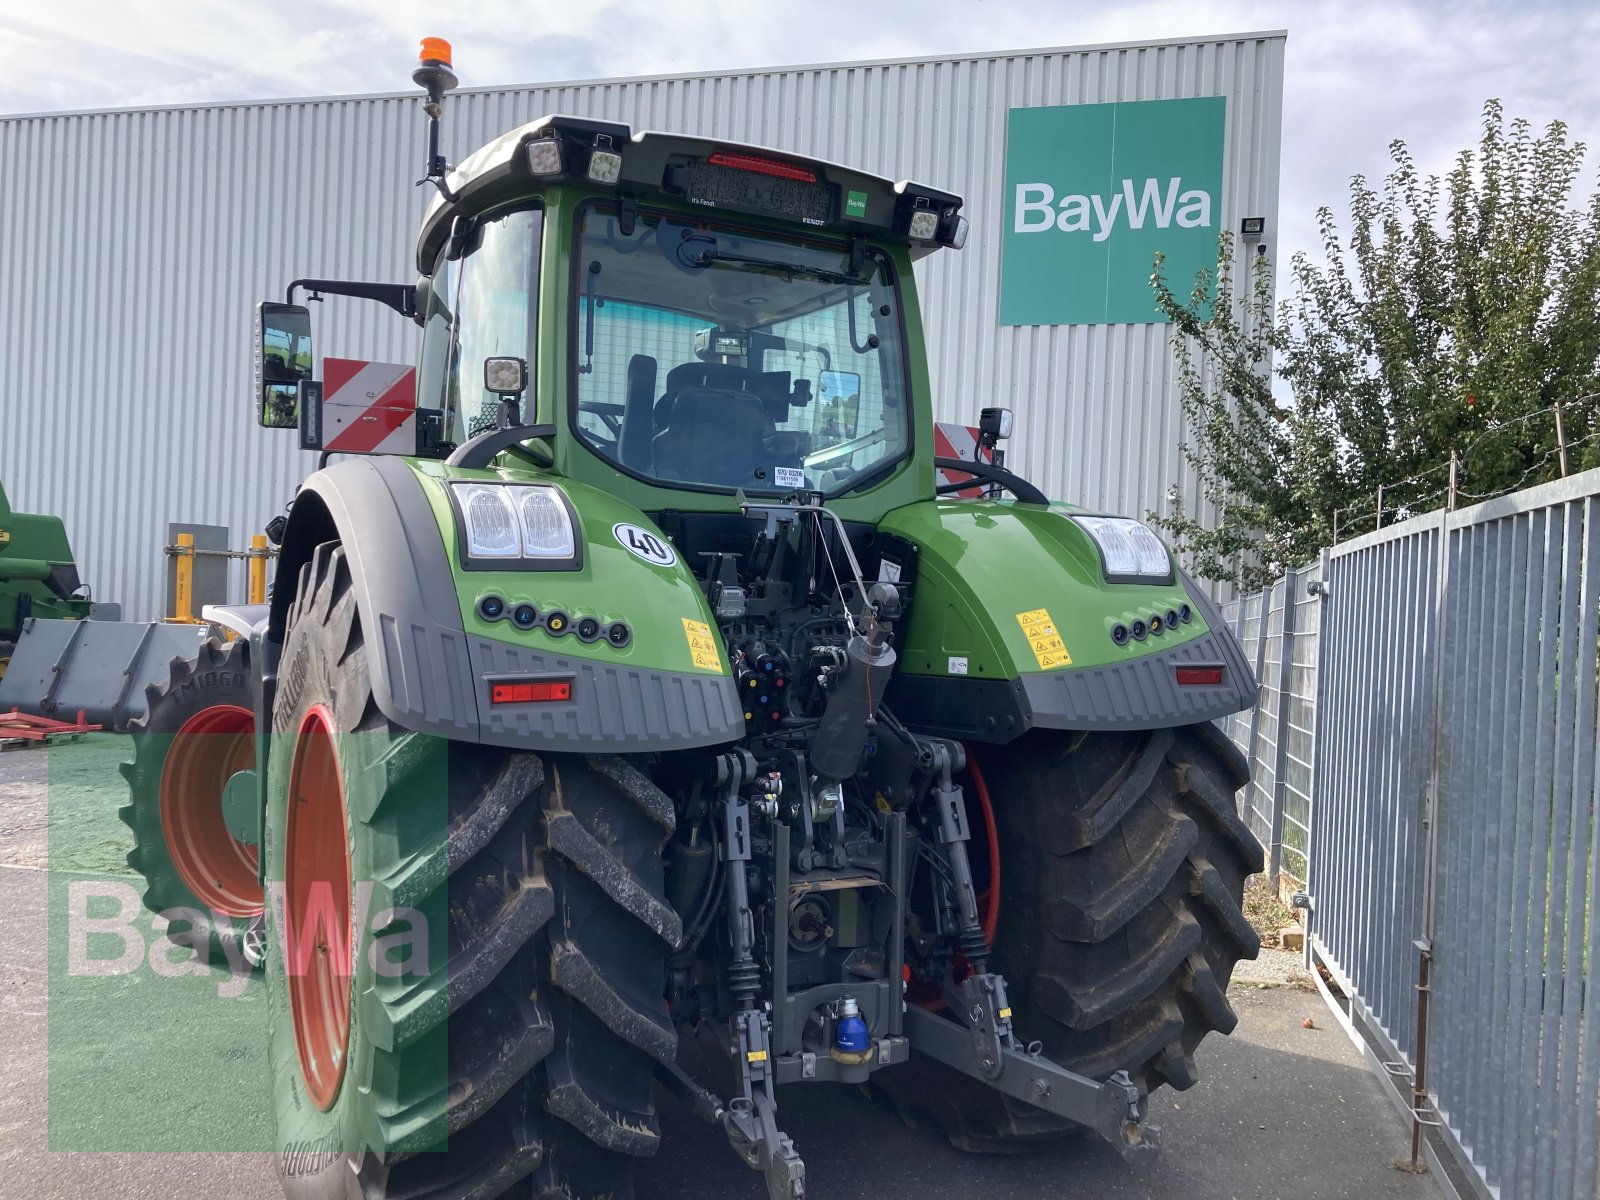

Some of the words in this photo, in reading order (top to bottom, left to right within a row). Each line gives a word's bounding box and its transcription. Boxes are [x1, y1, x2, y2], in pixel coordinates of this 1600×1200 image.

[848, 199, 865, 208] BayWa
[1014, 177, 1211, 242] BayWa
[803, 217, 825, 226] FENDT
[627, 528, 667, 560] 40
[273, 632, 310, 740] TRELLEBORG
